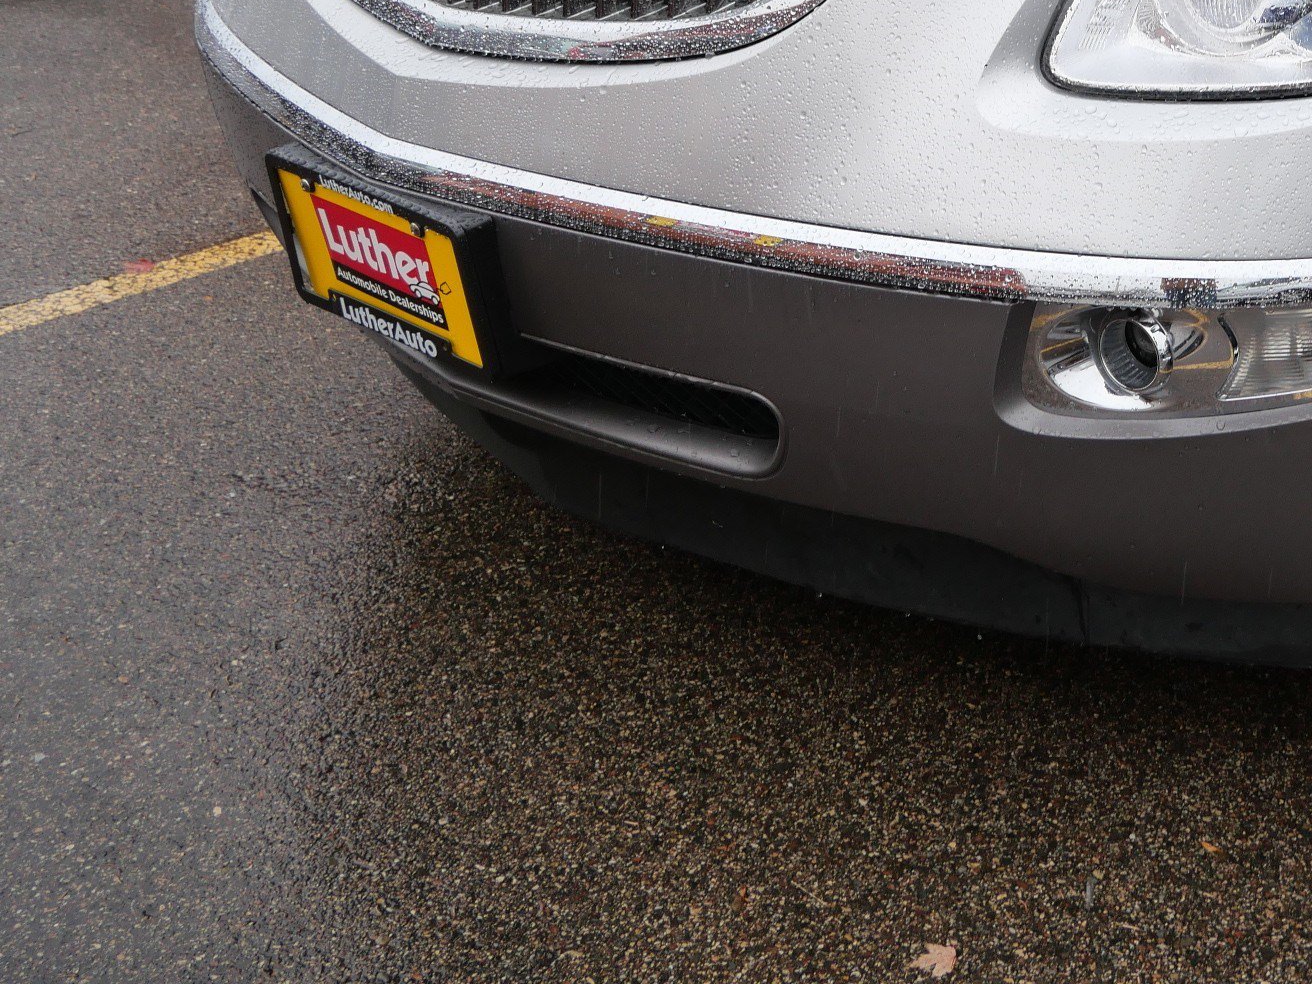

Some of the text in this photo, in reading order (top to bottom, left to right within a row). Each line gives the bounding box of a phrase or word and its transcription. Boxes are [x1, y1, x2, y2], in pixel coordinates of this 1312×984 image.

[319, 175, 394, 214] LutherAuto.com
[317, 208, 429, 285] Luther
[337, 268, 444, 324] Automobile Dealerships
[339, 297, 437, 358] LutherAuto
